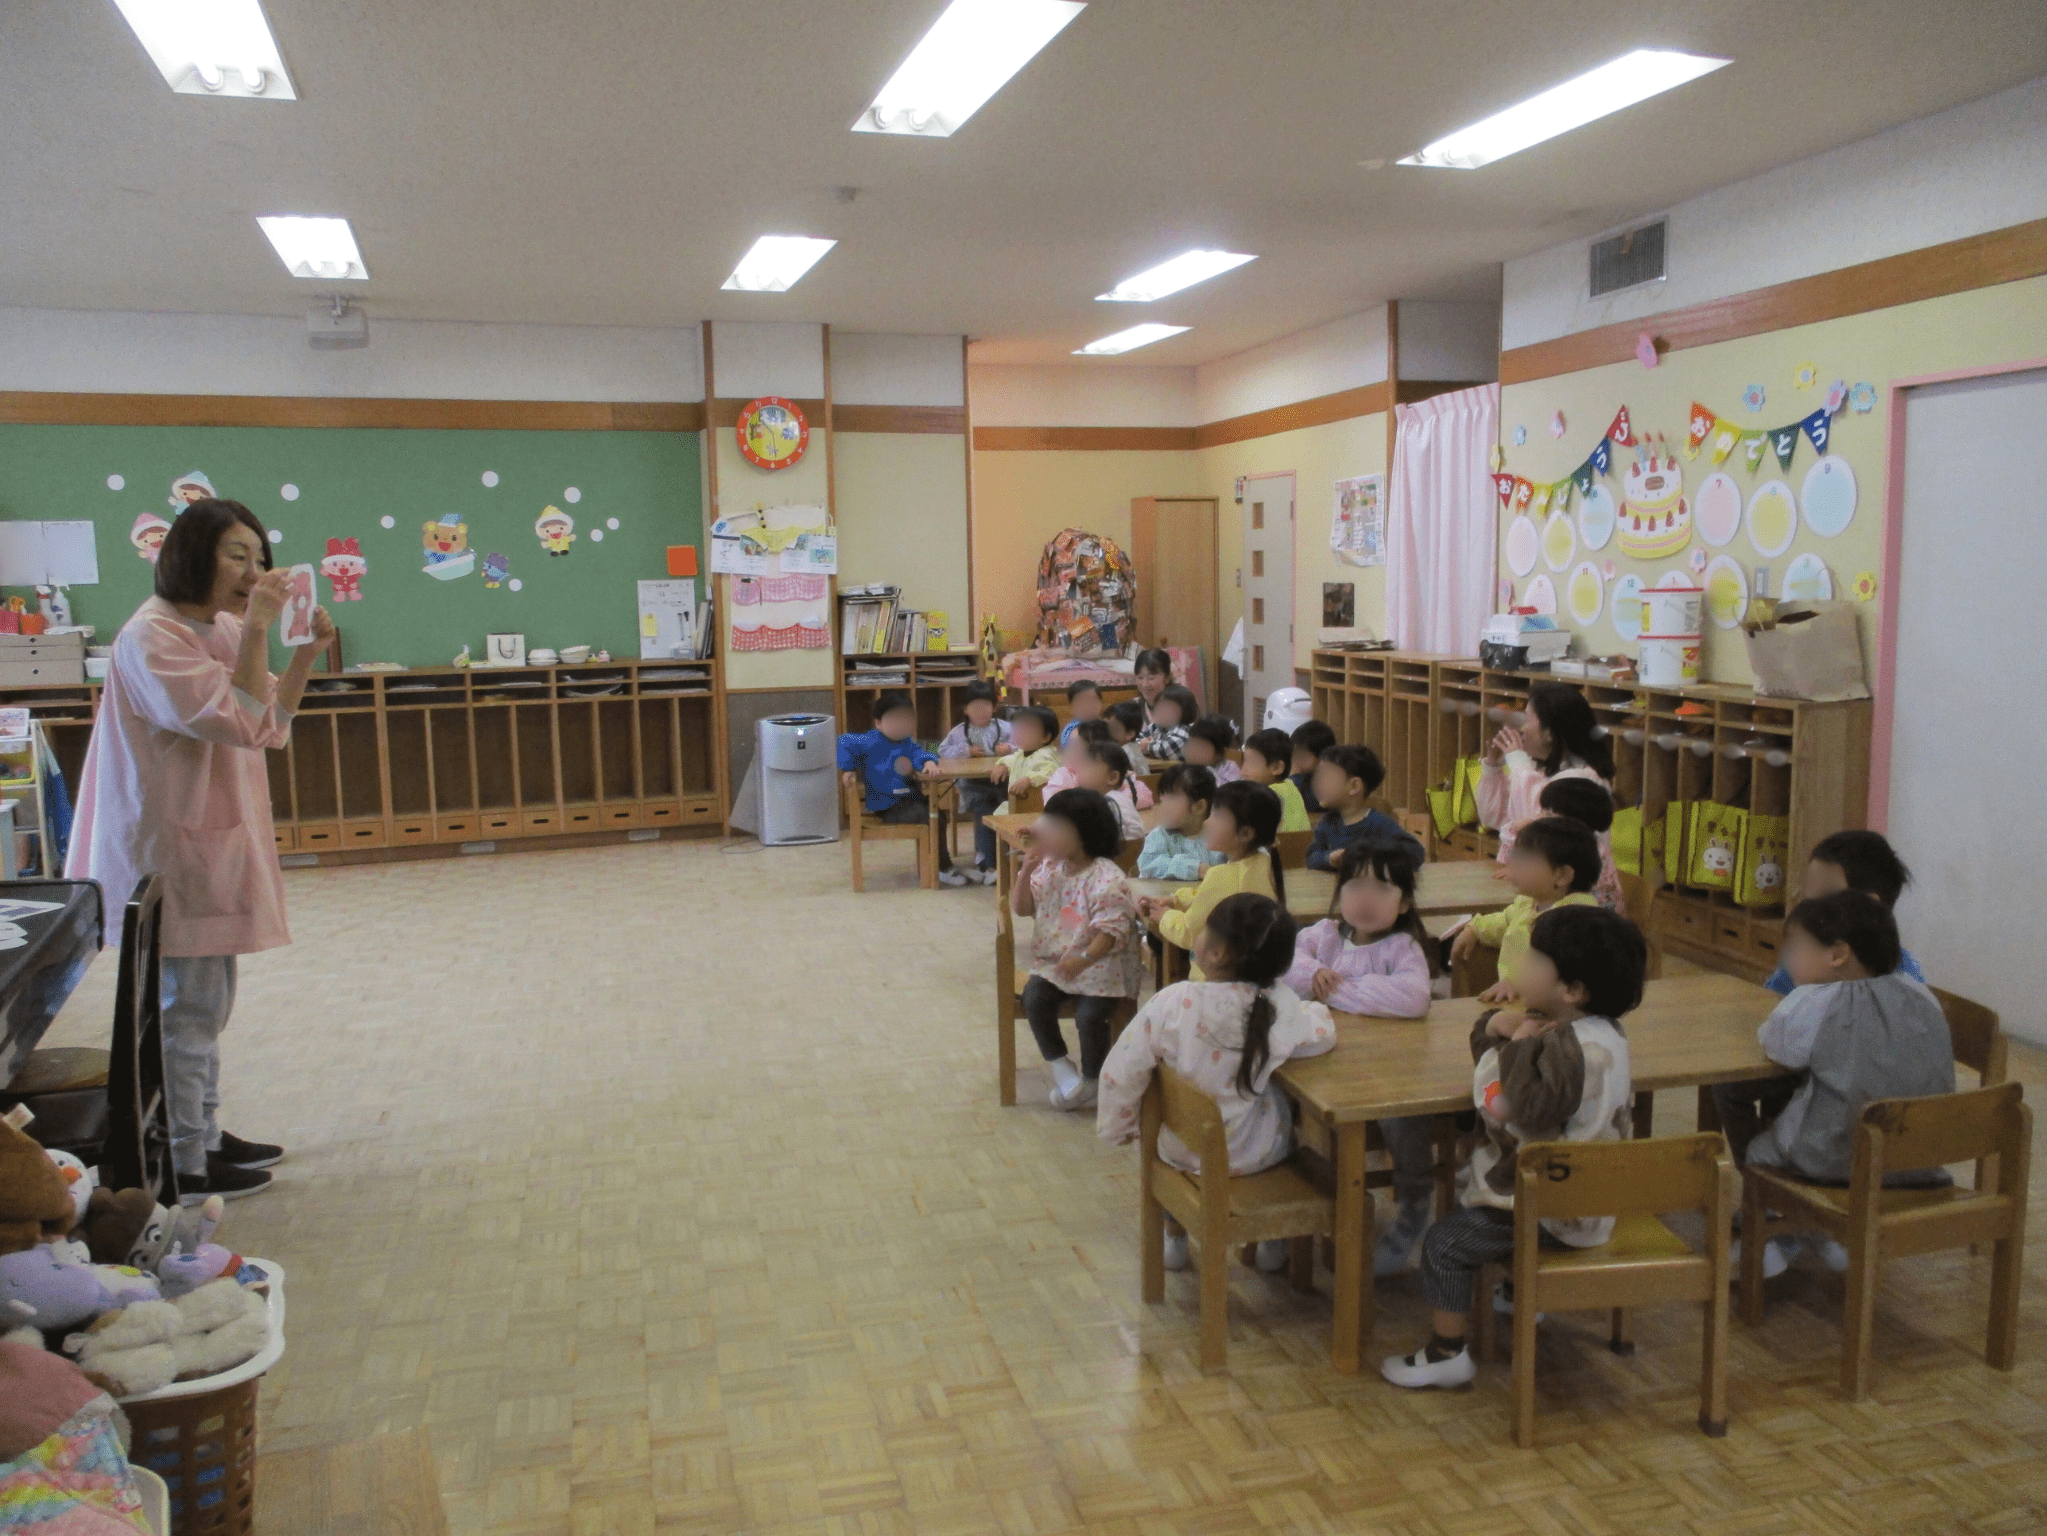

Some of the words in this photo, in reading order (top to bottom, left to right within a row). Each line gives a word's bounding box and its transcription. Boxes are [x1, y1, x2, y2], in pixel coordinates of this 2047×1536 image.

[1824, 463, 1831, 474] 9
[1716, 479, 1722, 488] 7
[1627, 578, 1634, 588] 12
[1547, 1153, 1571, 1182] 5
